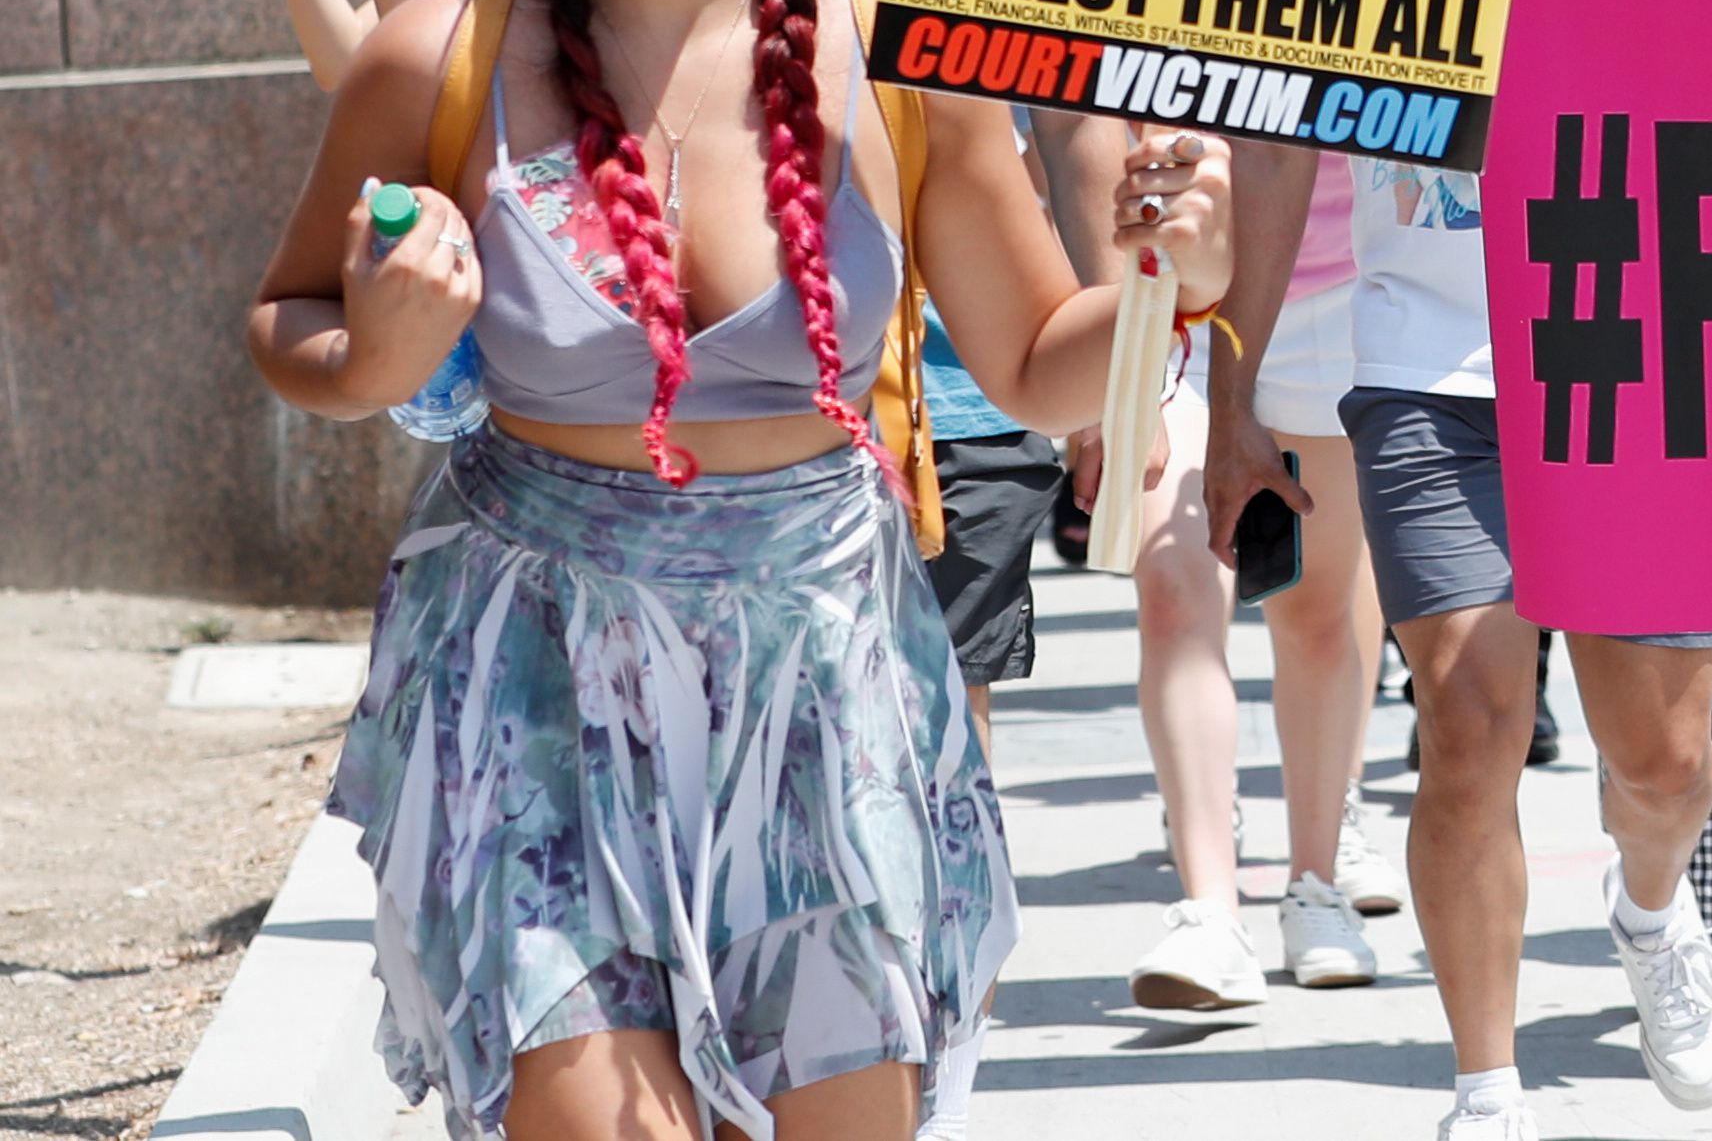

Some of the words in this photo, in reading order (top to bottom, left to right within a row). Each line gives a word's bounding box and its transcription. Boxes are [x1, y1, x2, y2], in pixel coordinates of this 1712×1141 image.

[897, 16, 1459, 157] COURTVICTIM.COM
[1073, 13, 1146, 38] WITNESS
[1147, 24, 1253, 55] STATEMENTS
[1257, 41, 1269, 57] &
[1271, 43, 1411, 79] DOCUMENTATION
[1413, 65, 1469, 88] PROVE
[1469, 74, 1486, 91] IT
